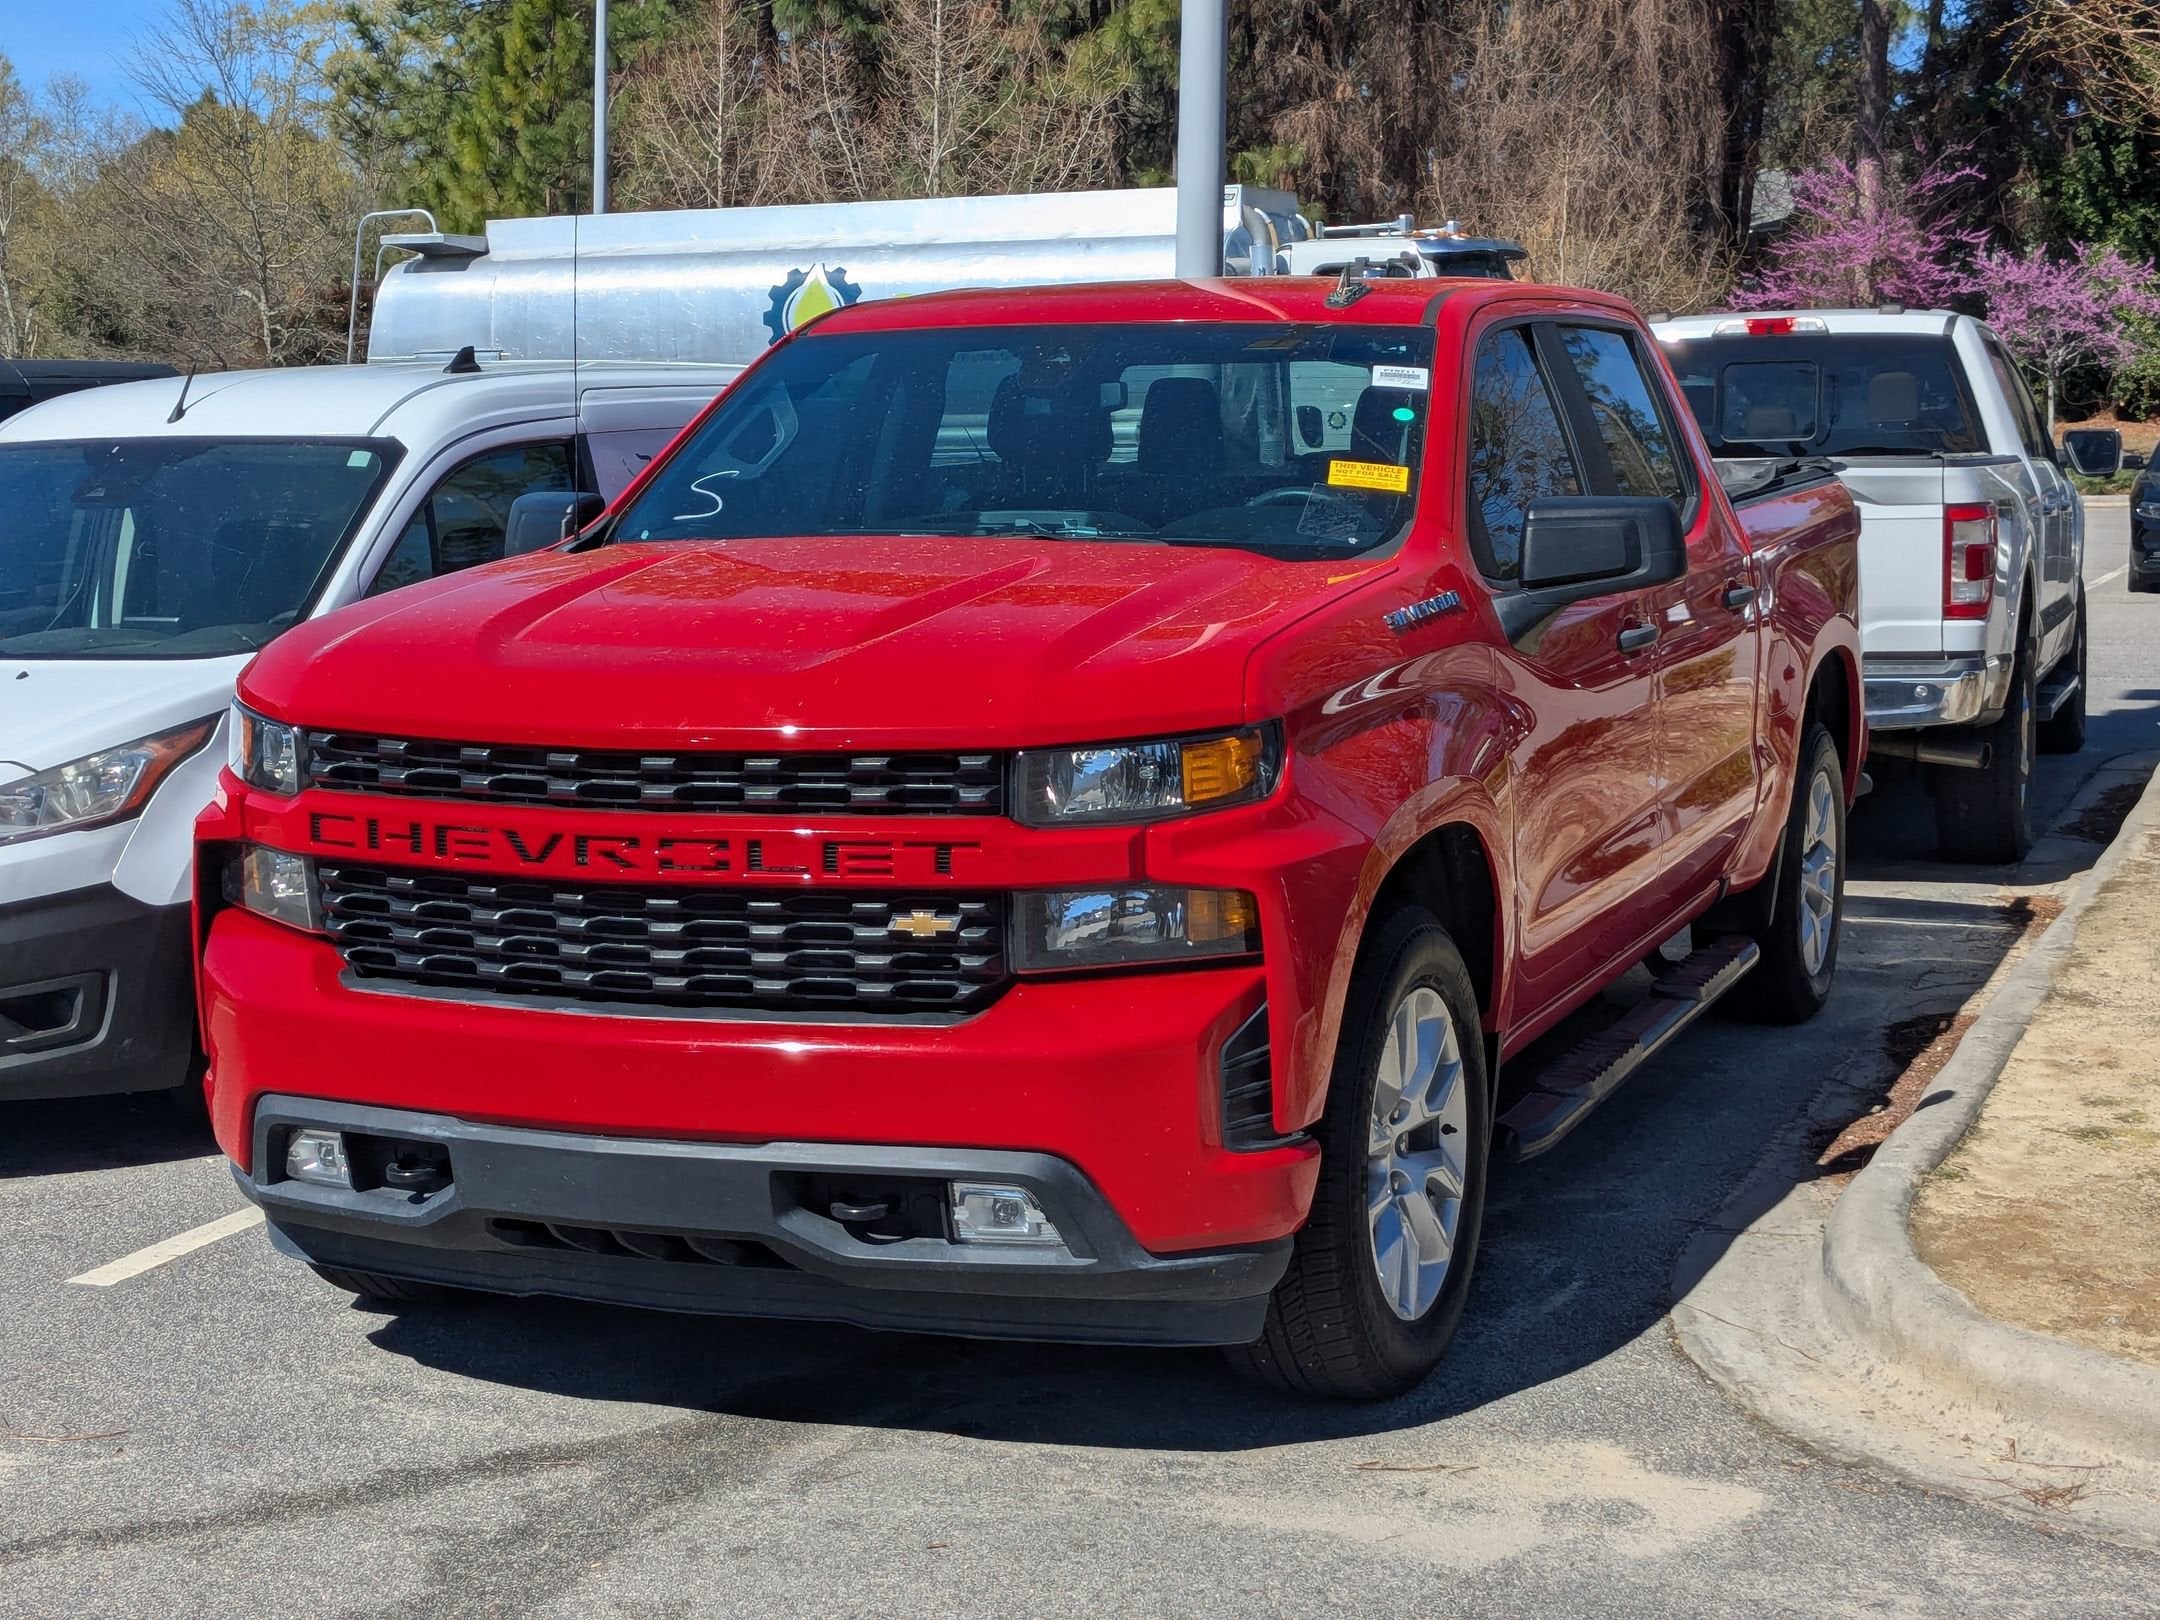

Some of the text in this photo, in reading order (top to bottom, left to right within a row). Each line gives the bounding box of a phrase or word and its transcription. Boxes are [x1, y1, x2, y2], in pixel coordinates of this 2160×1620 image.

[1334, 462, 1404, 474] THIS VEHICLE
[309, 811, 984, 878] CHEVROLET
